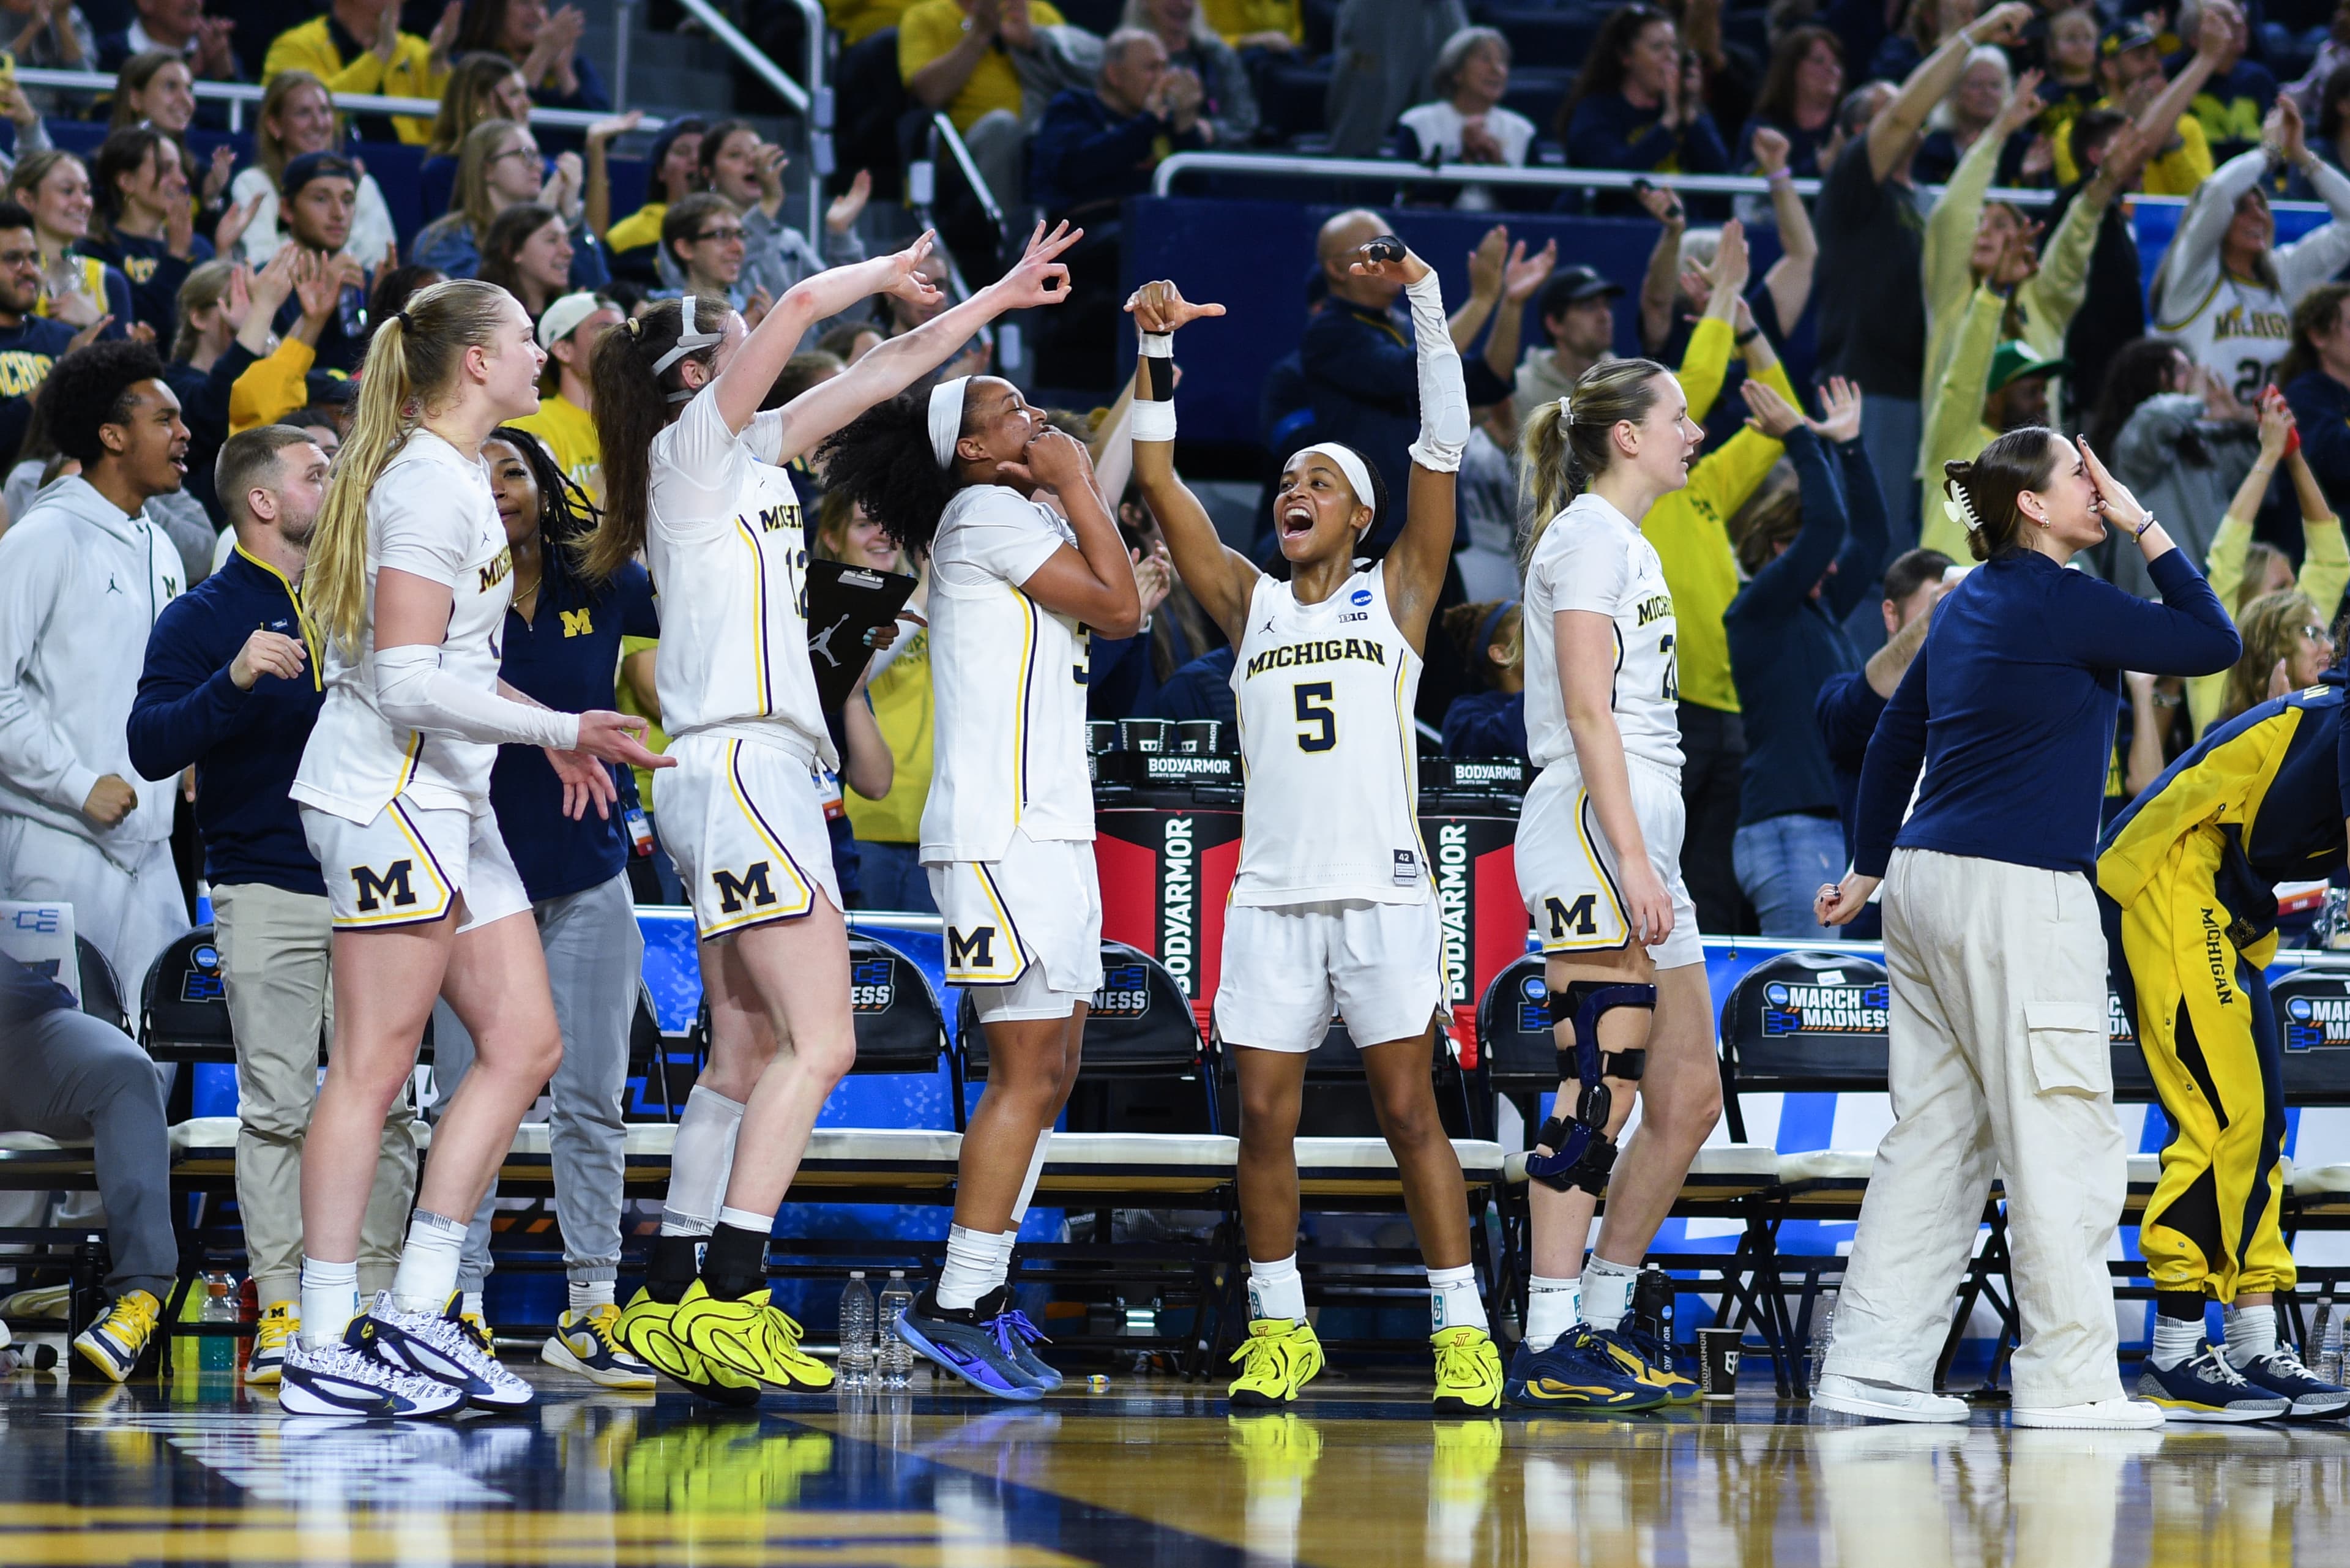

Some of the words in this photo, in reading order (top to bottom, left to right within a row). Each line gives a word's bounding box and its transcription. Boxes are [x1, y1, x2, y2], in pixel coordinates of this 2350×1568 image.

[162, 575, 177, 599] M
[1354, 595, 1373, 603] NCAA
[559, 608, 592, 638] M
[1245, 638, 1386, 682] MICHIGAN
[1293, 681, 1337, 754] 5
[1148, 758, 1231, 774] BODYARMOR
[1454, 765, 1521, 780] BODYARMOR
[1398, 853, 1409, 862] 42
[351, 859, 418, 912] M
[712, 861, 778, 914] M
[1165, 818, 1192, 995] BODYARMOR
[1545, 894, 1598, 938] M
[948, 925, 996, 968] M
[2201, 903, 2233, 1006] MICHIGAN
[1789, 987, 1860, 1009] MARCH
[1802, 1008, 1889, 1028] MADNES
[271, 1307, 285, 1318] M
[1699, 1332, 1709, 1392] BODYARMOR
